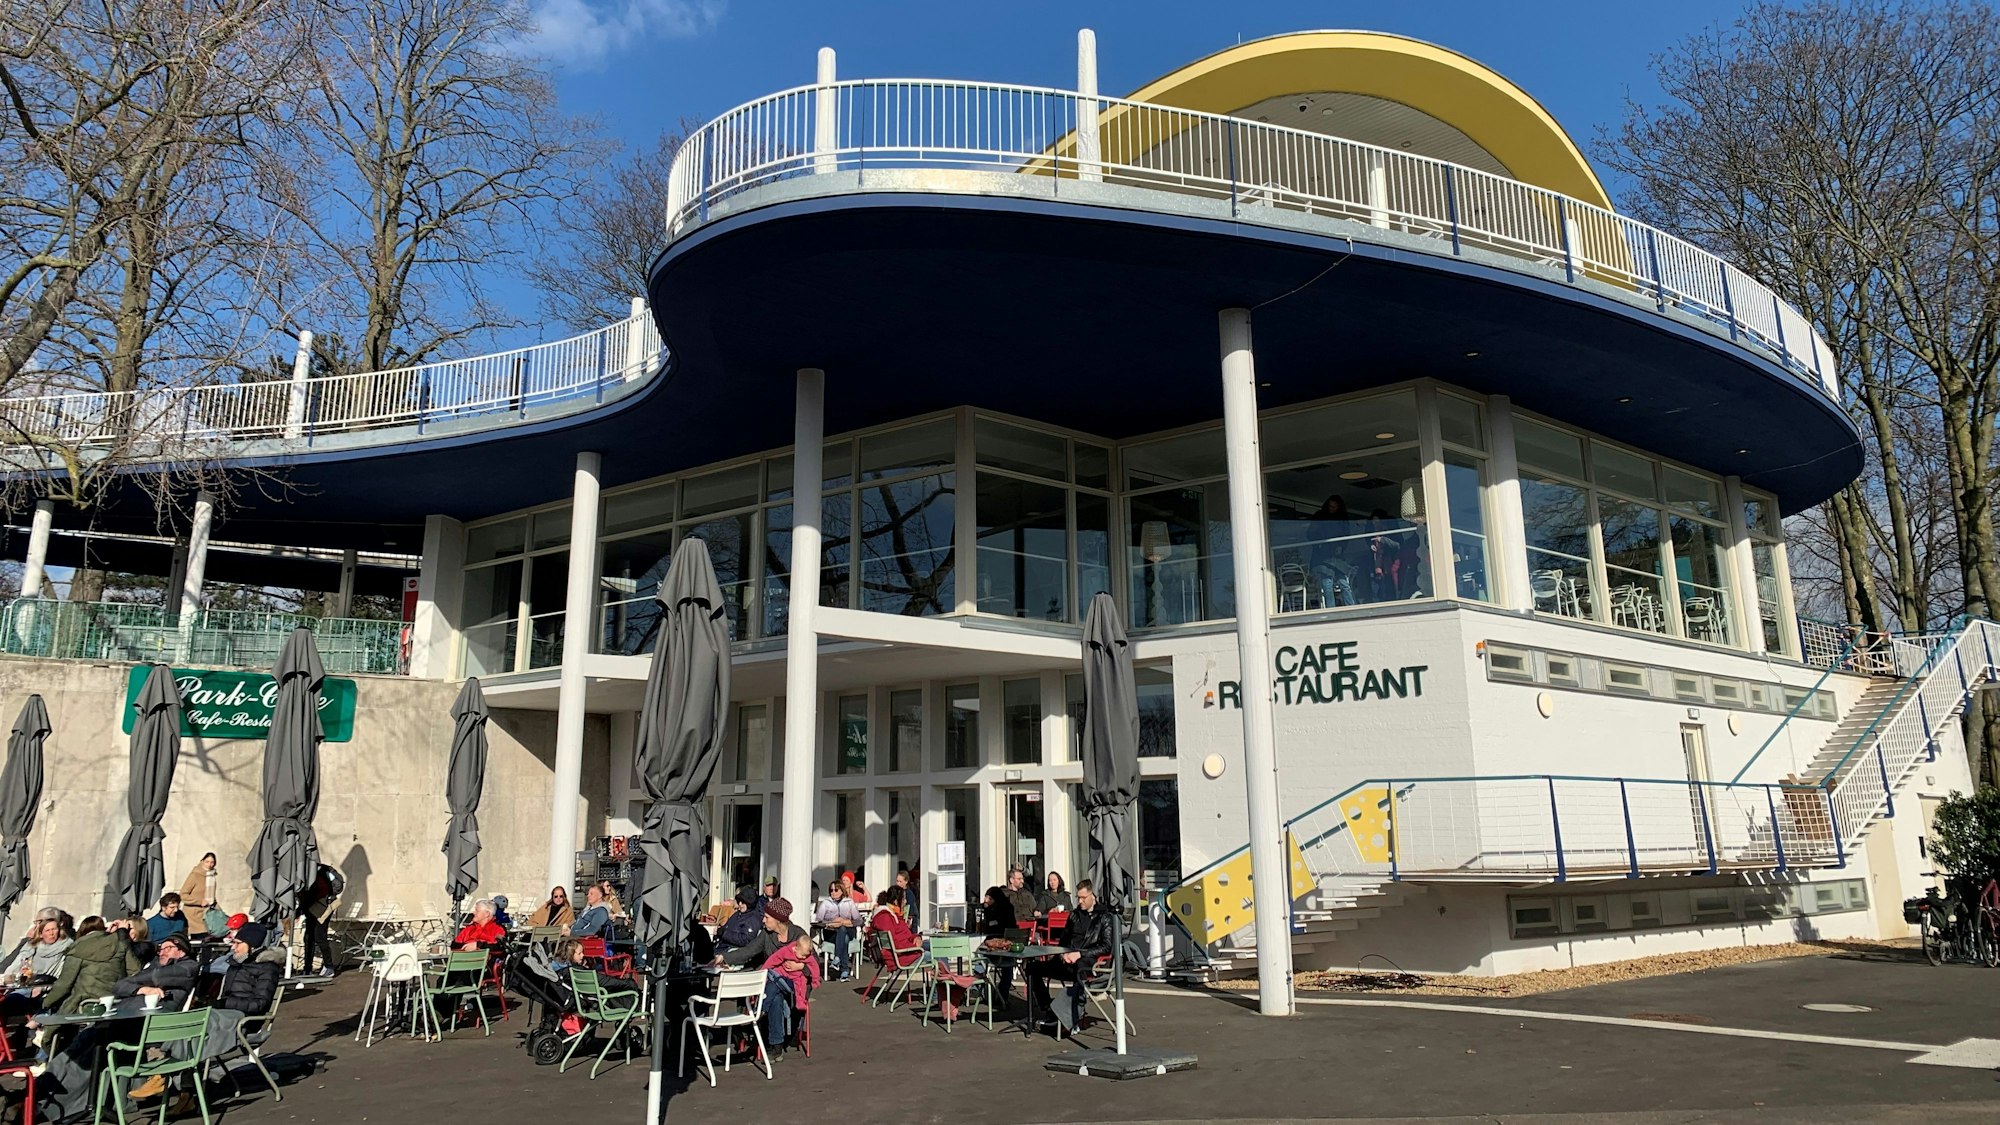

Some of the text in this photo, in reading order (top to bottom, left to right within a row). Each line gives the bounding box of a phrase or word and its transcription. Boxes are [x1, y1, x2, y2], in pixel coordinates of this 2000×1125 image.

[1275, 641, 1360, 676] CAFE
[175, 676, 335, 711] Park-Ce
[1218, 665, 1429, 710] RTAURANT
[187, 709, 273, 731] Cafe-Resta
